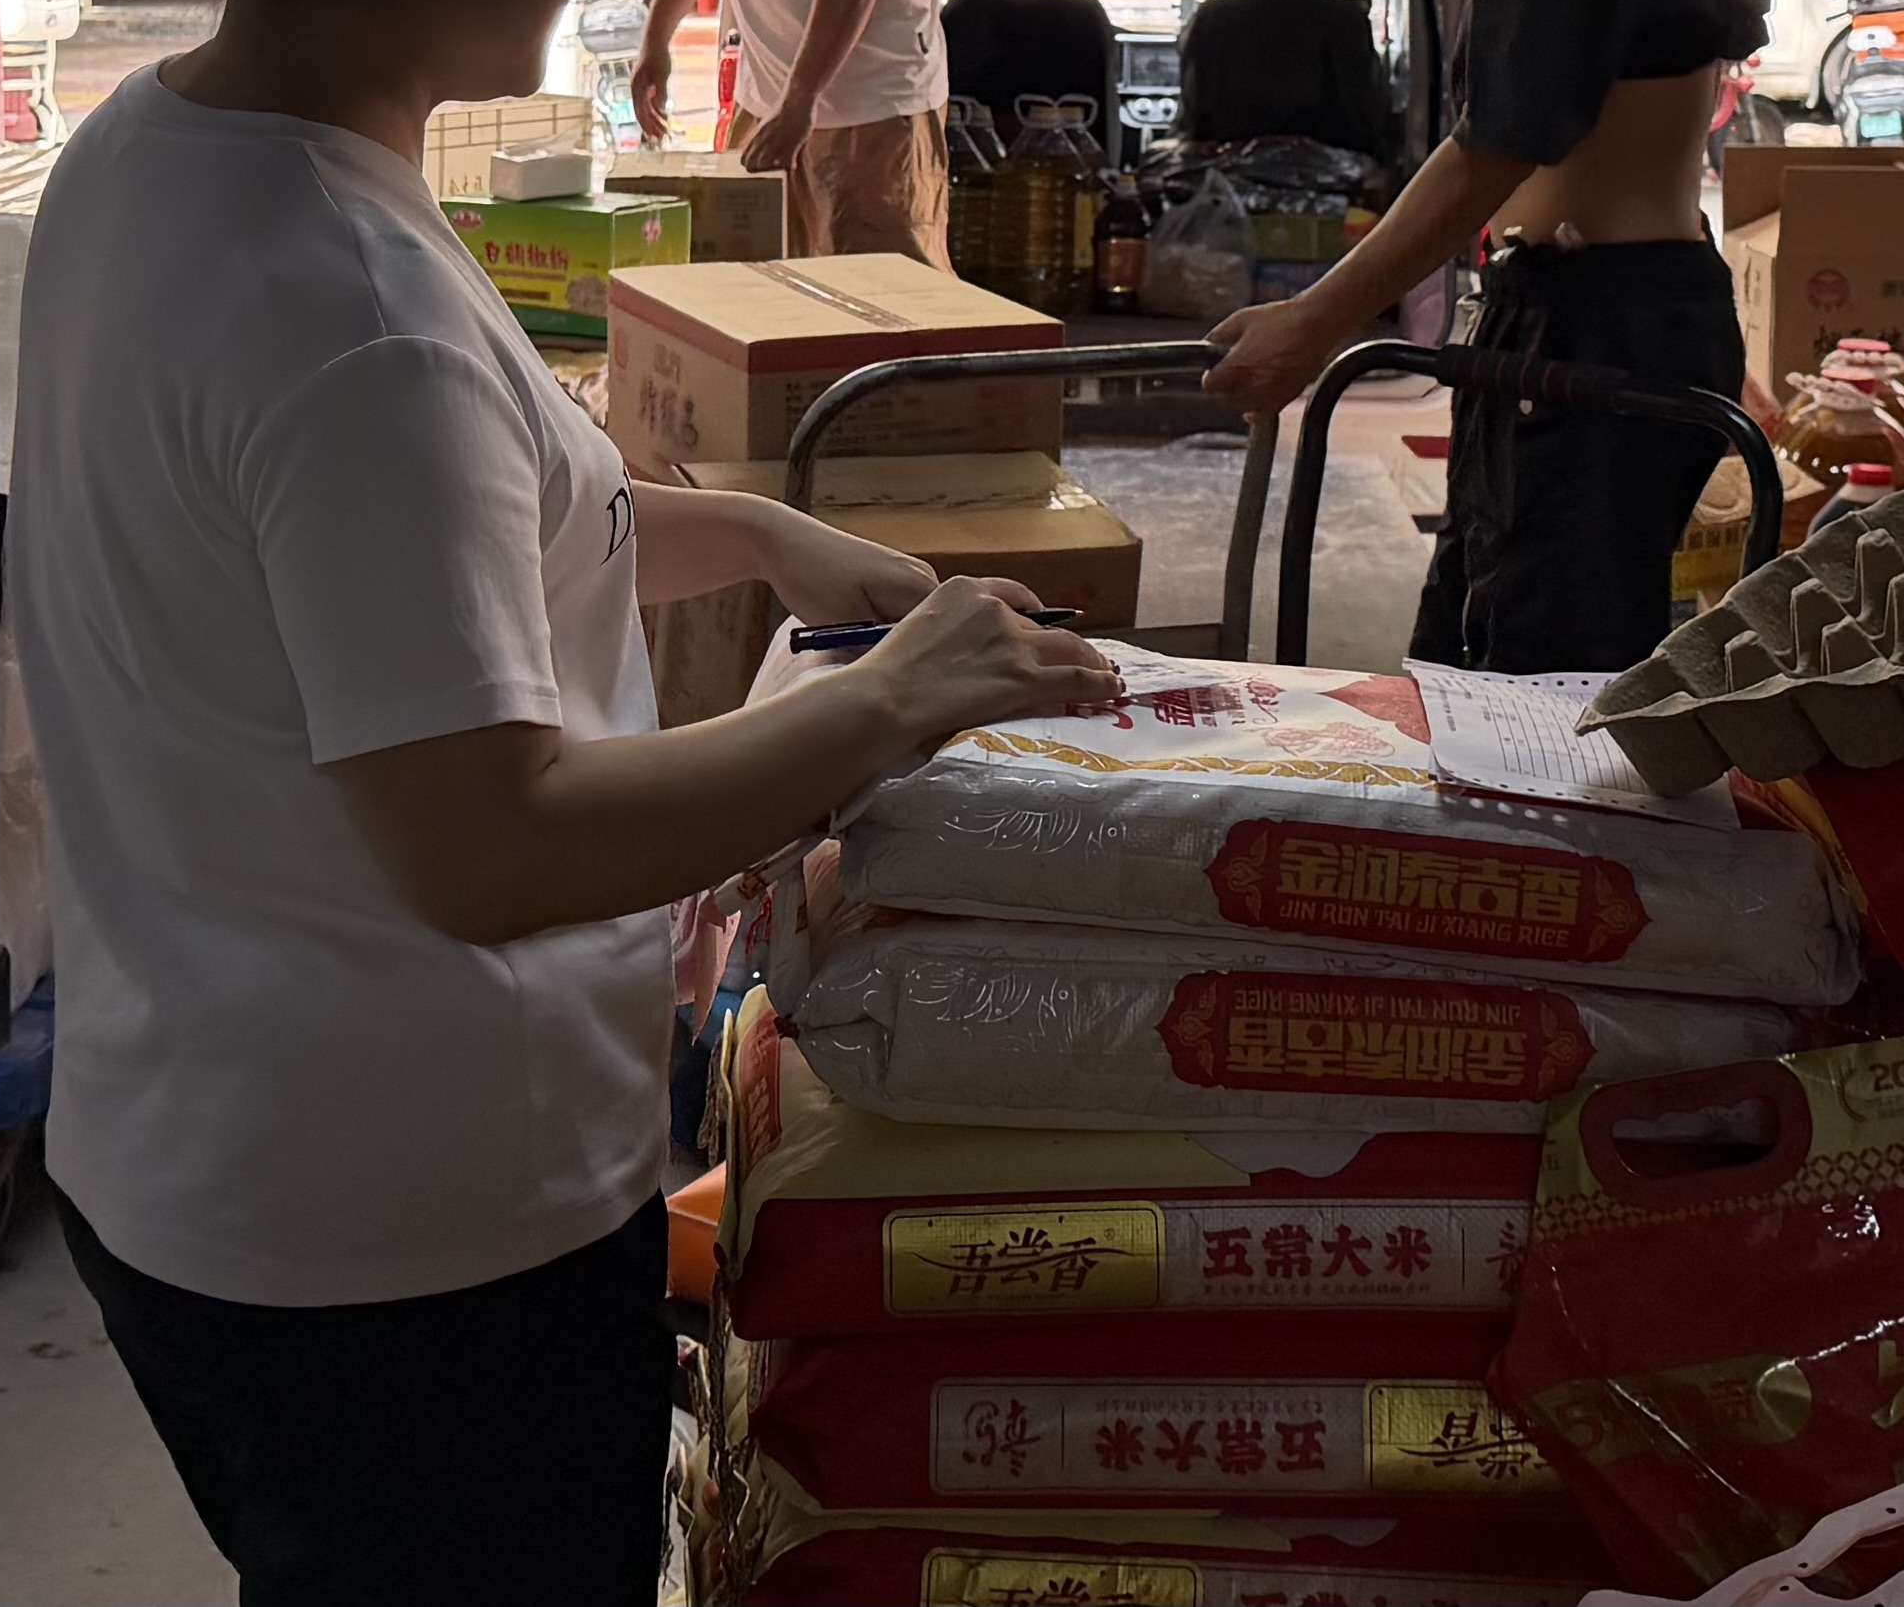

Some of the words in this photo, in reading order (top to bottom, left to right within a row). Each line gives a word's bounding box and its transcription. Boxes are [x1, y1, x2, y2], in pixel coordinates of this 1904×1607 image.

[1277, 837, 1582, 926] 金润泰吉香
[1280, 900, 1315, 922] JIN
[1321, 904, 1369, 926] RUN
[1373, 910, 1411, 932] TAI
[1415, 914, 1436, 935] JI
[1444, 917, 1513, 945] XIANG
[1518, 925, 1571, 949] RICE
[1234, 989, 1284, 1012] RICE
[1293, 991, 1358, 1014] XIANG
[1364, 995, 1385, 1016] JI
[1389, 997, 1427, 1020] TAI
[1433, 999, 1480, 1023] RUN
[1484, 1003, 1521, 1025] JIN
[1227, 1015, 1528, 1086] 金润泰吉香
[1202, 1224, 1433, 1281] 五常大米
[1095, 1417, 1328, 1476] 五常大米
